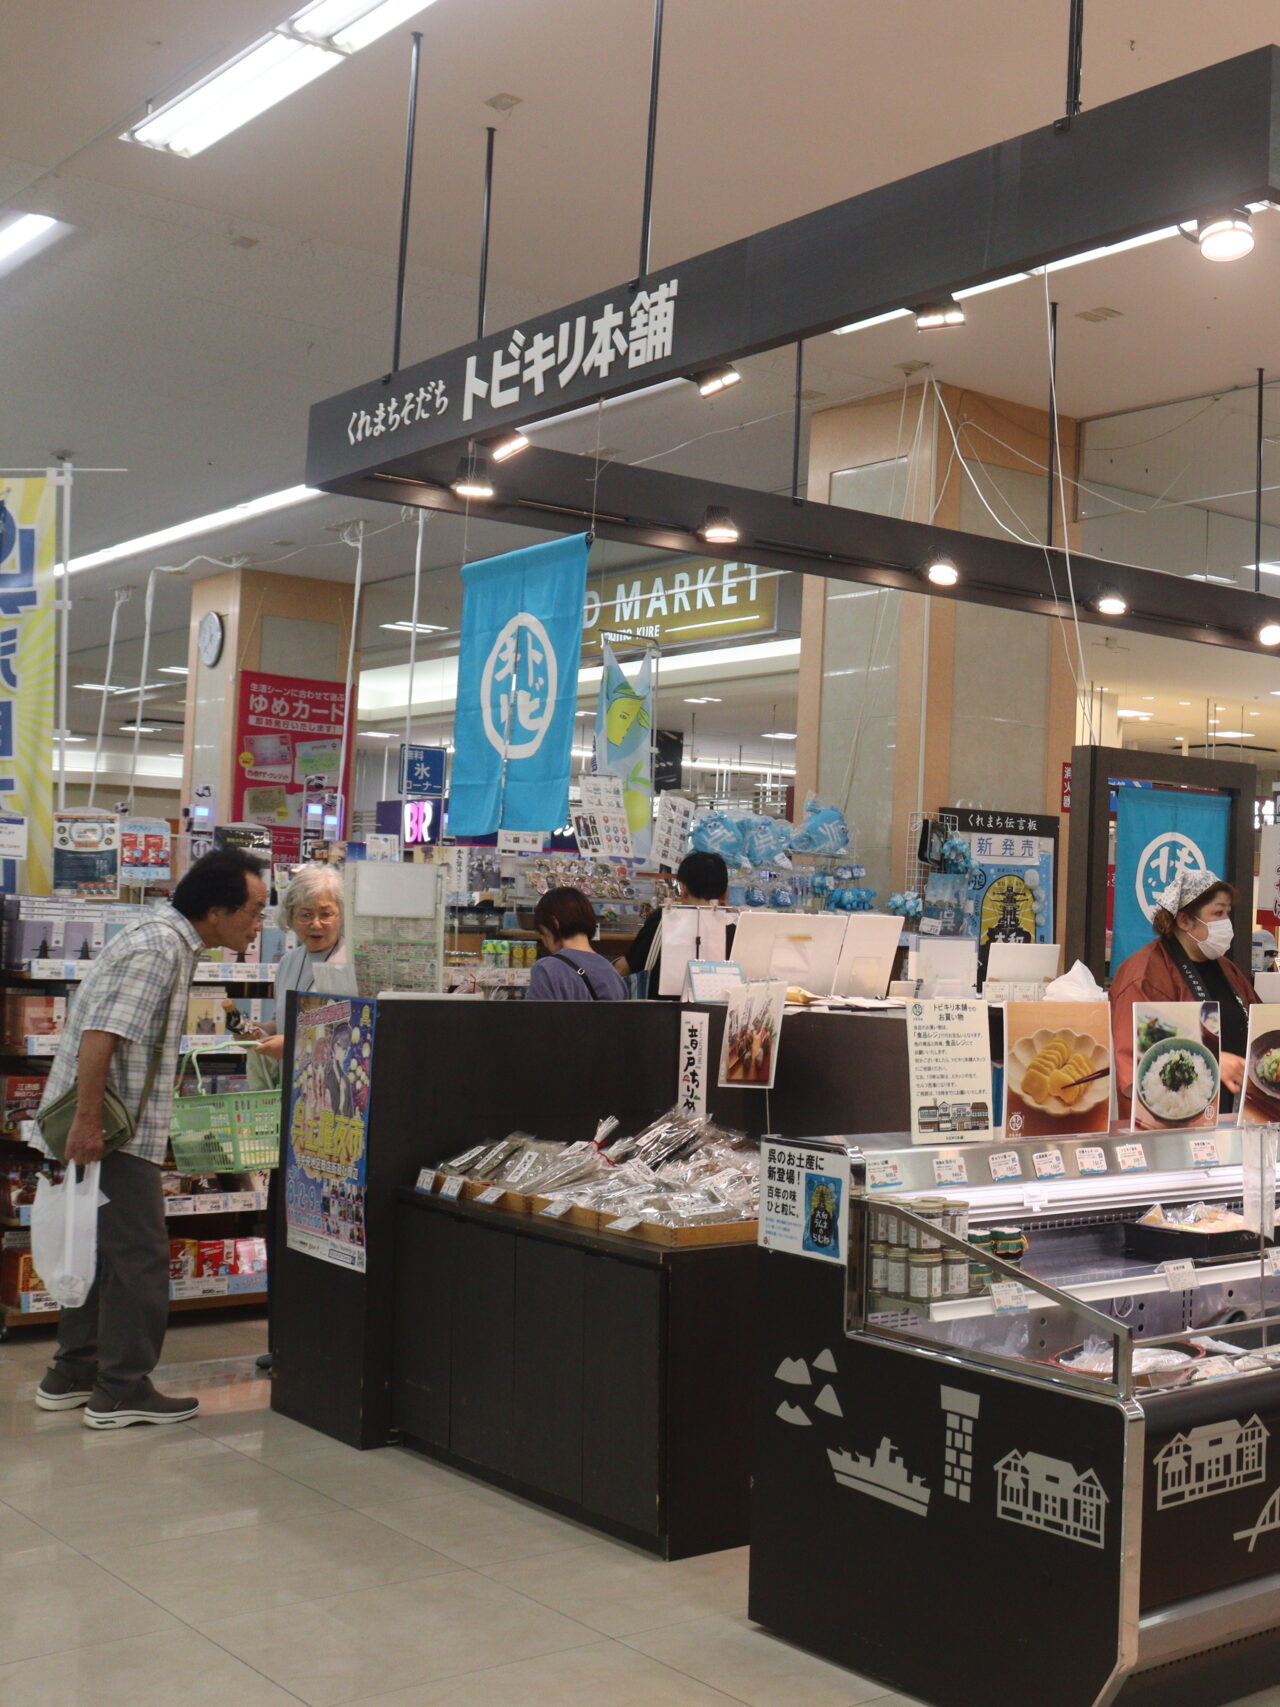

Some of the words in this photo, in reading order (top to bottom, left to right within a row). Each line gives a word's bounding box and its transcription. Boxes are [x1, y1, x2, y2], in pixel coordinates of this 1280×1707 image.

[347, 378, 449, 446] くれまちそだち
[462, 278, 679, 422] トビキリ本舗
[614, 562, 770, 623] MARKET
[413, 762, 431, 780] 氷
[968, 813, 1038, 832] くれまち伝言板
[767, 1148, 825, 1171] 呉のお土産に
[767, 1185, 798, 1203] 百年の味
[766, 1200, 799, 1219] ひと粒に。
